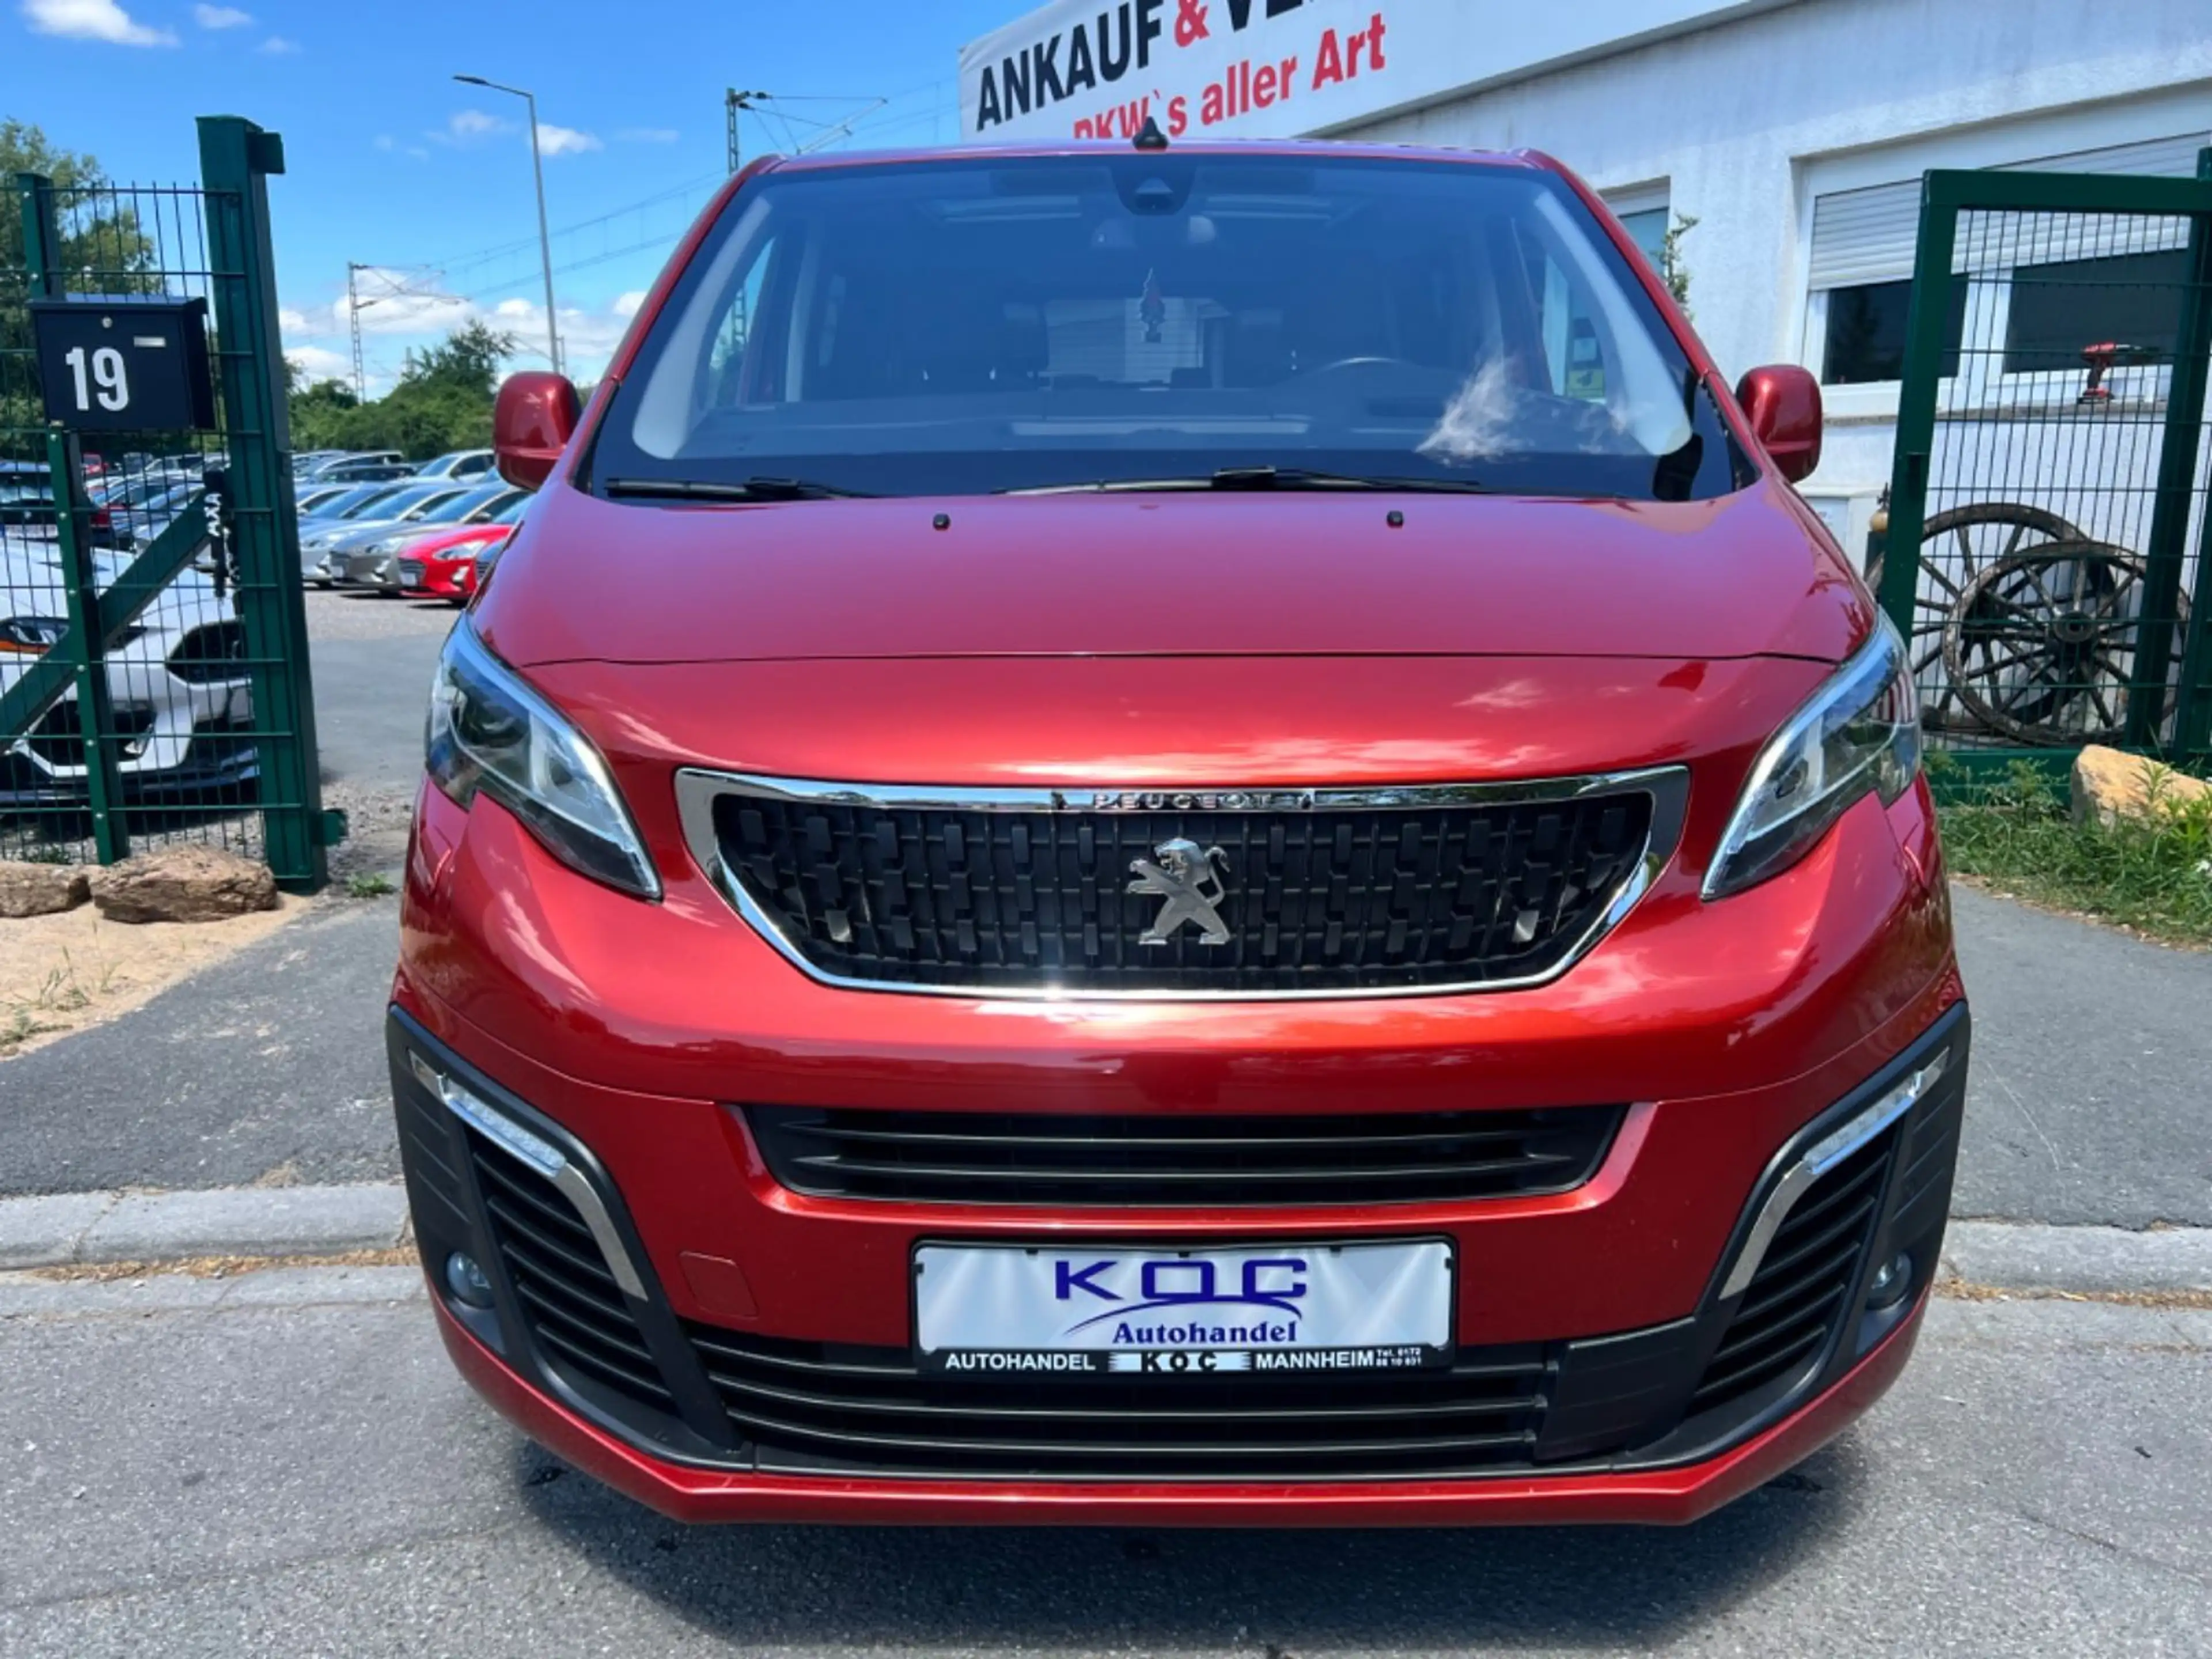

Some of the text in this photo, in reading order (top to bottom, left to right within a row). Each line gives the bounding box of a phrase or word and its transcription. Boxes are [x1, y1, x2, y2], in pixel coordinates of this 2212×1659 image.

[976, 0, 1164, 131] ANKAUF
[1201, 55, 1297, 126] aller
[1312, 13, 1385, 91] Art
[66, 346, 130, 412] 19
[945, 1353, 1096, 1371] AUTOHANDEL
[1255, 1350, 1375, 1370] MANNHEIM
[1112, 1320, 1297, 1344] Autohandel
